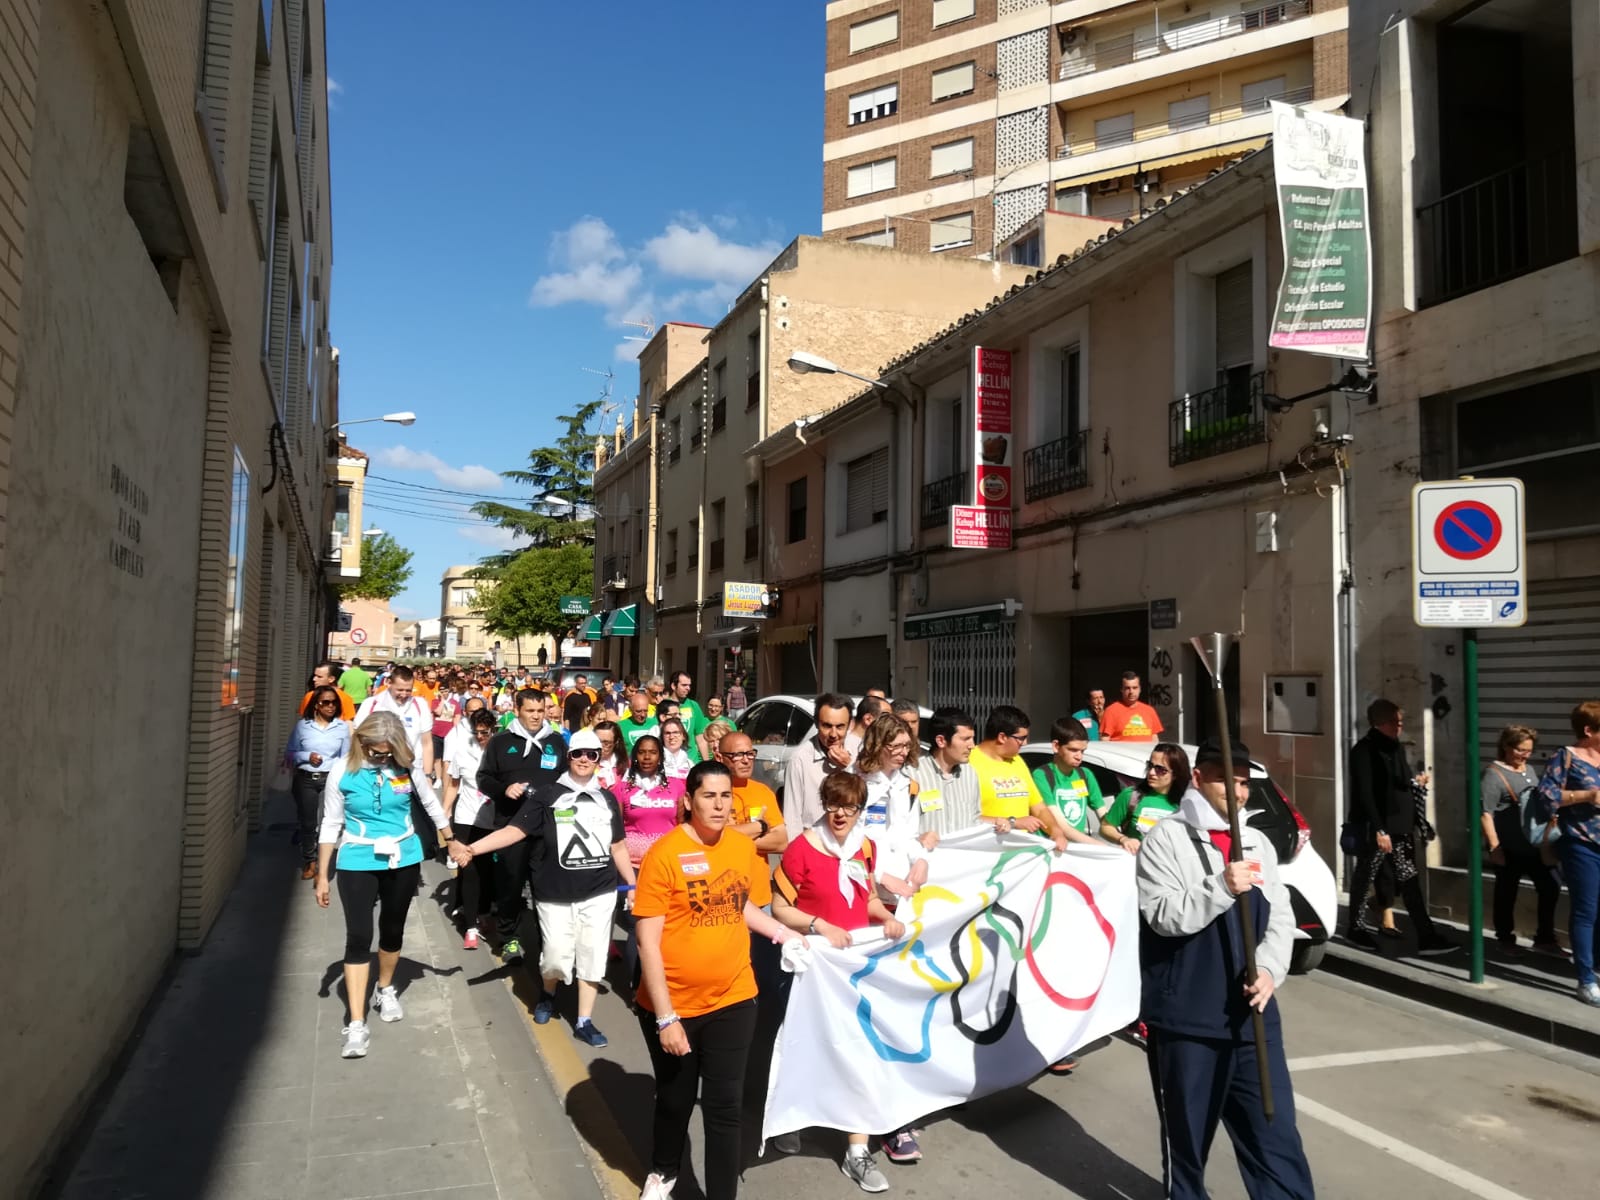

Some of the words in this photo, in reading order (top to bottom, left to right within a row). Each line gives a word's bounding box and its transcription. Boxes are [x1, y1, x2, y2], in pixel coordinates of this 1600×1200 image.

[1337, 220, 1363, 230] Adultas
[1310, 284, 1320, 293] de
[1320, 282, 1346, 293] Estudio
[1319, 299, 1344, 310] Escolar
[1322, 318, 1365, 330] OPOSICIONES
[978, 372, 1011, 390] HELLÍN
[982, 399, 1006, 407] TURCA
[974, 511, 1010, 528] HELLÍN
[955, 528, 985, 536] COMIDA
[729, 584, 760, 593] ASADOR
[689, 912, 741, 928] blanca
